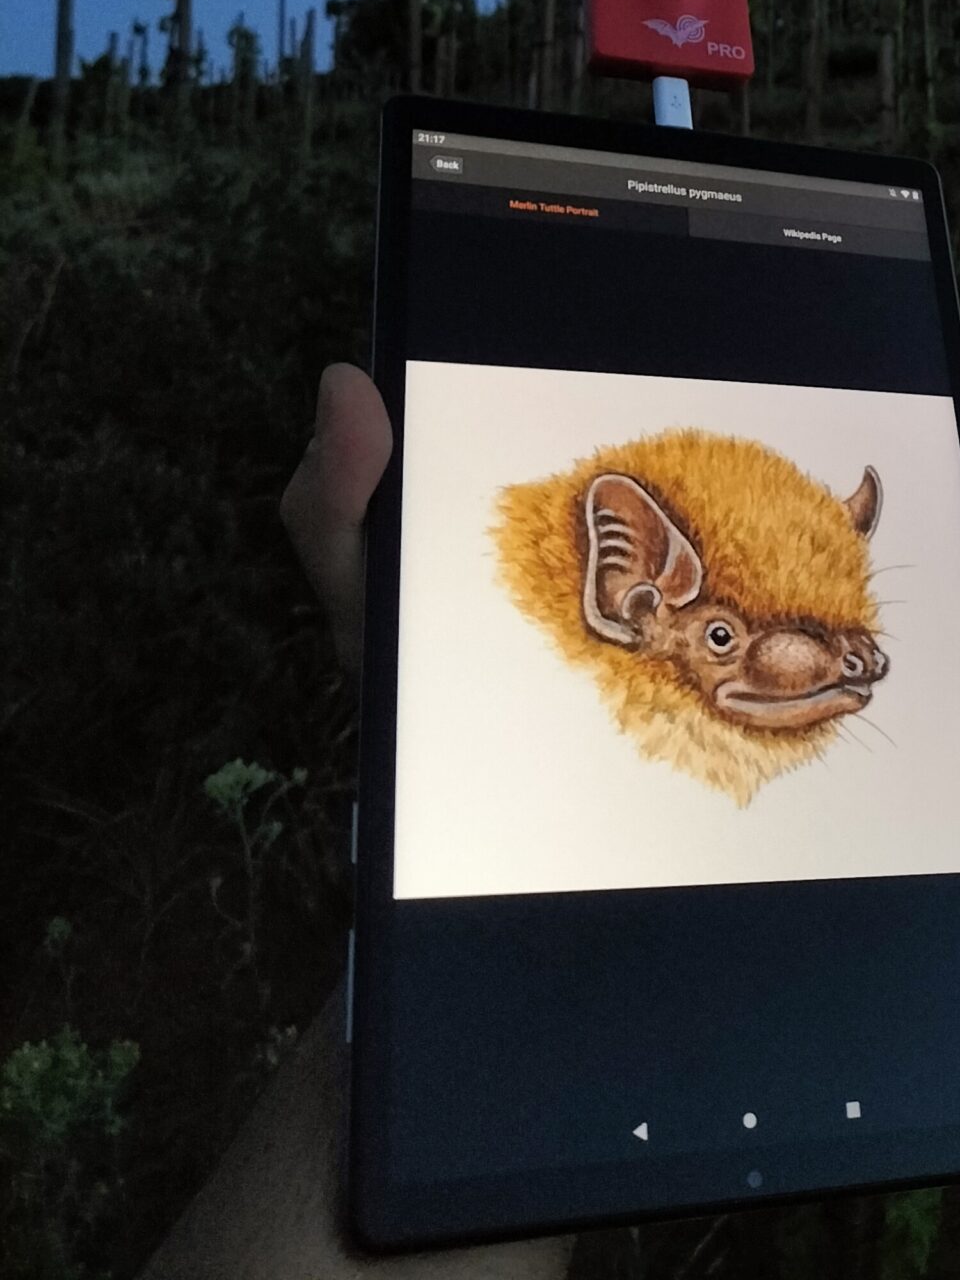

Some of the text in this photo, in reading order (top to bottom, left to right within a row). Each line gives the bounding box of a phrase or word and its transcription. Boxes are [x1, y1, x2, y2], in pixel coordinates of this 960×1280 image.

[707, 42, 745, 60] PRO
[417, 133, 446, 144] 21:17
[436, 159, 459, 170] Back
[627, 179, 742, 202] Pipistrellus pygmaeus
[509, 199, 599, 217] Merlin Tuttle Portrait
[783, 228, 842, 244] Wikipedia Page
